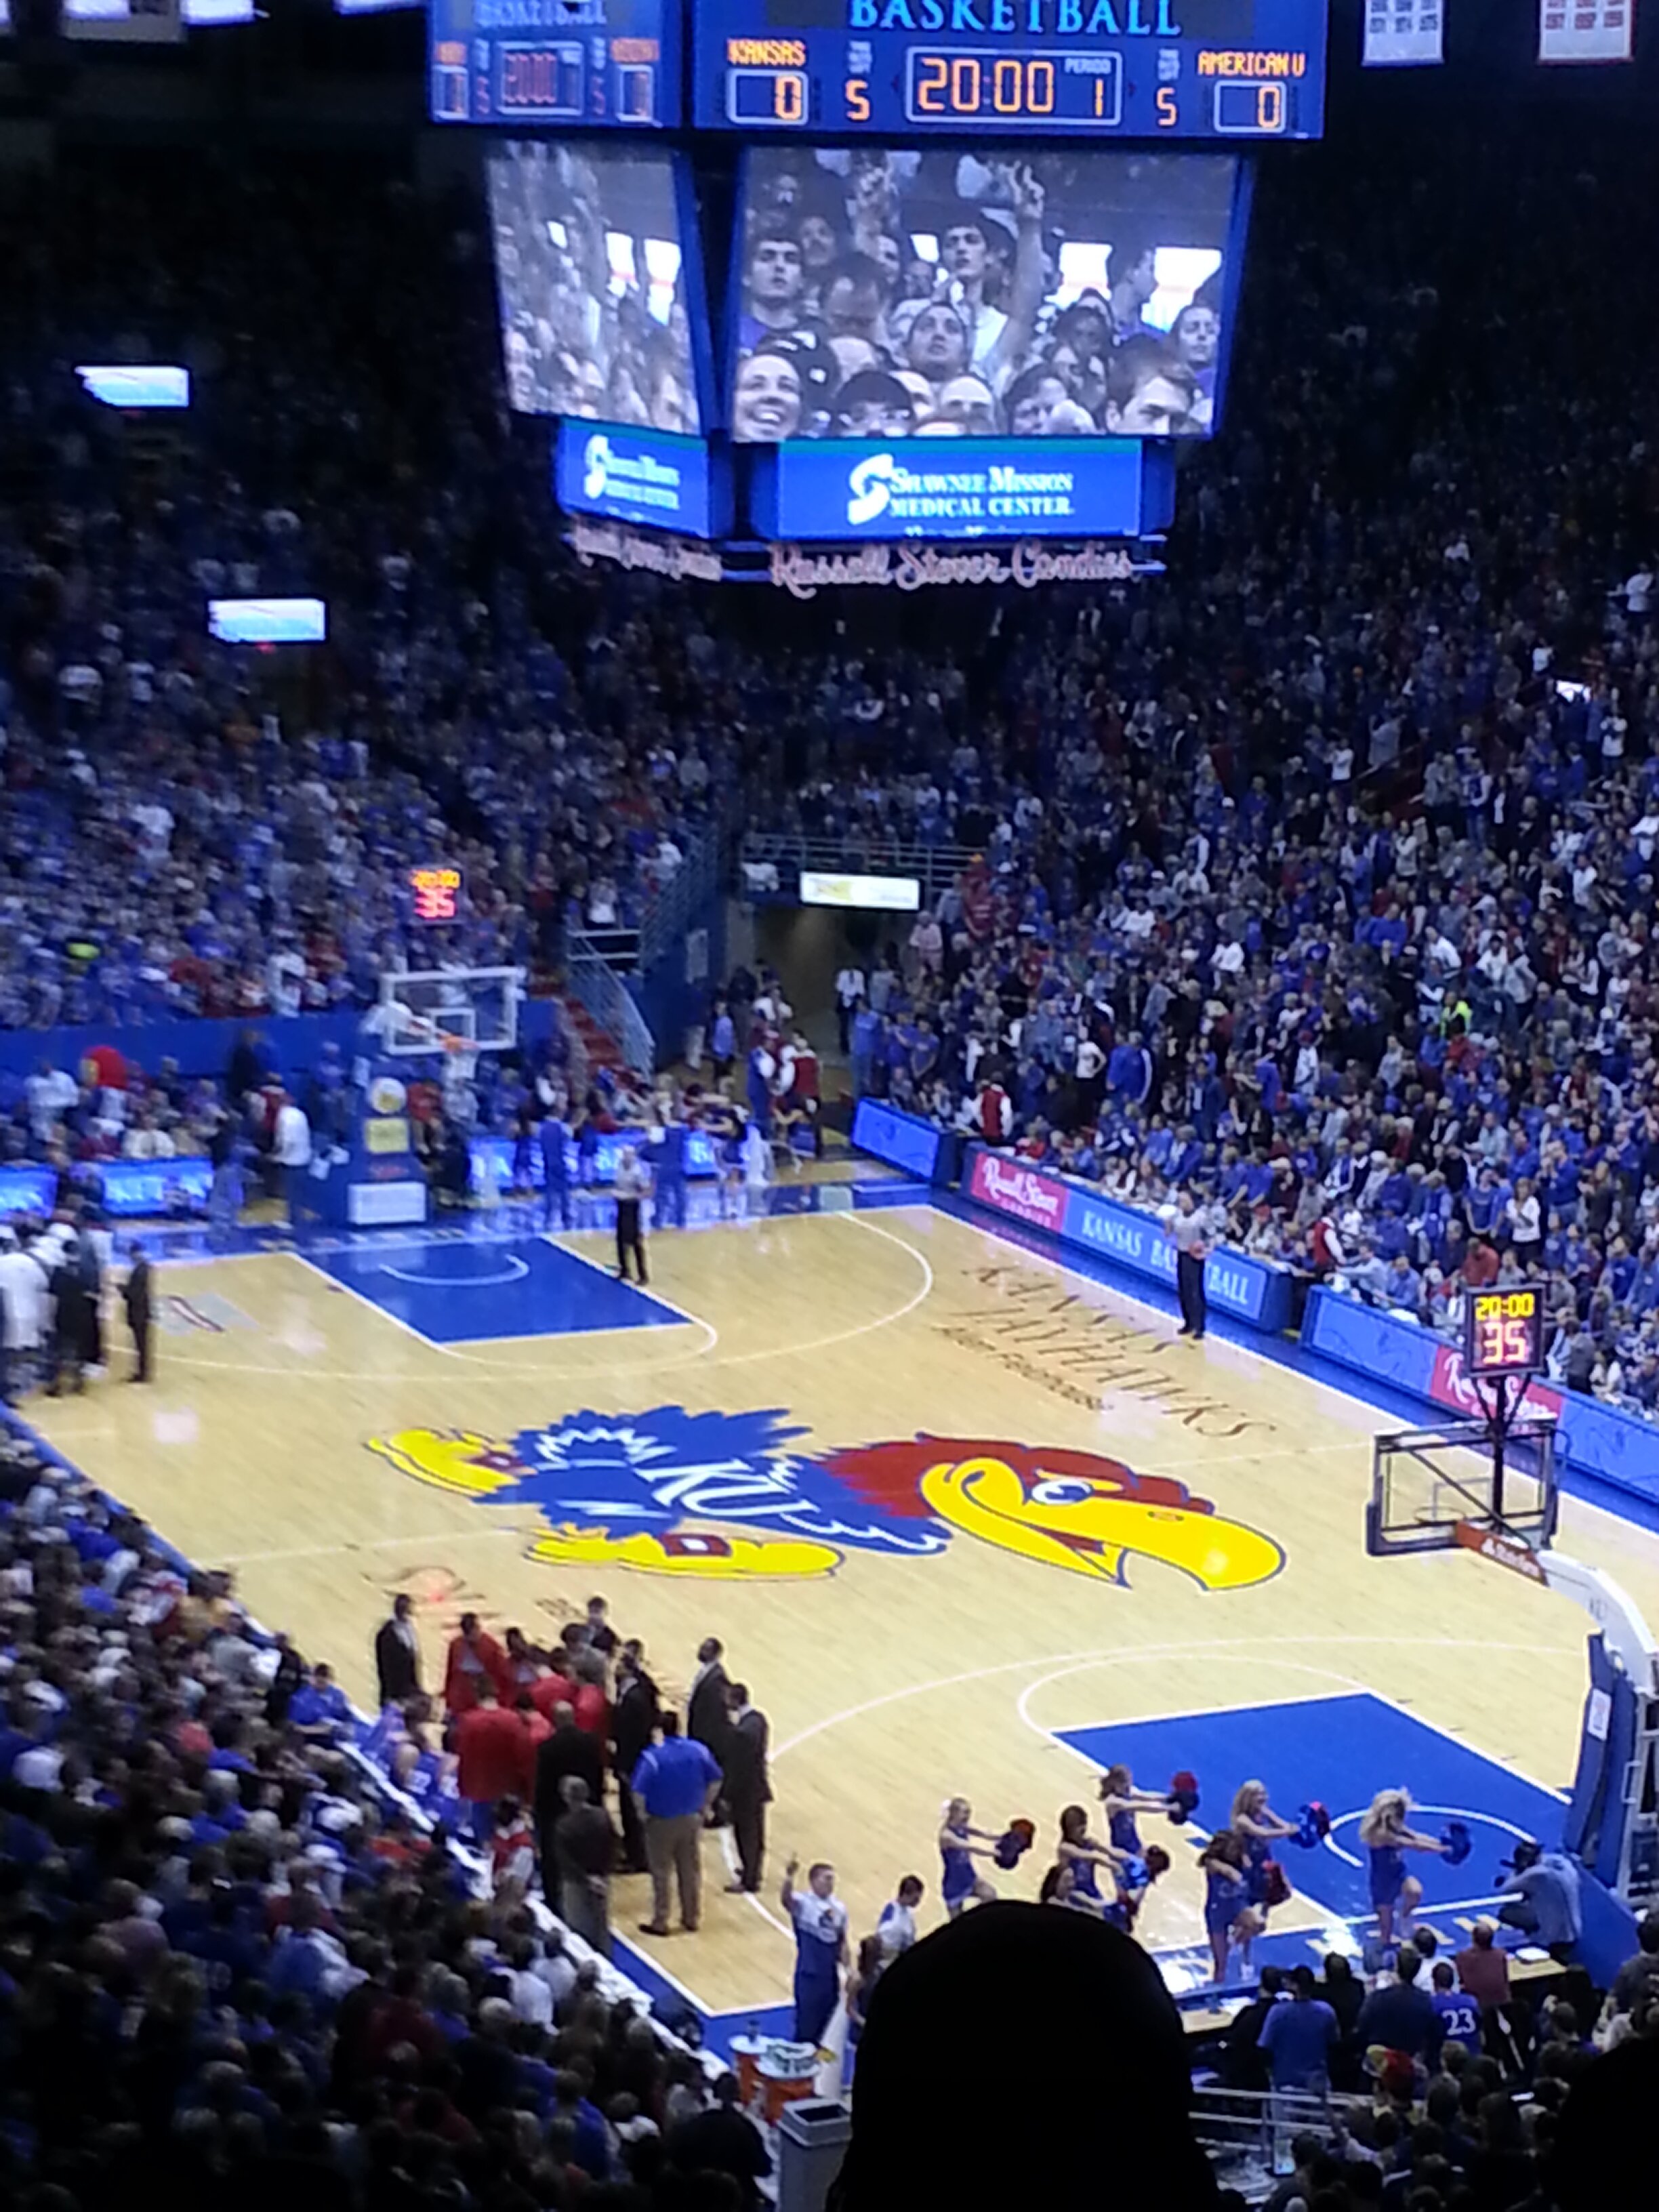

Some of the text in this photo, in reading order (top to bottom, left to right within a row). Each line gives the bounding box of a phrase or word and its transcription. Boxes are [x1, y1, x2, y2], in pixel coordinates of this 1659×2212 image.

[850, 0, 1180, 35] BASKETBALL
[727, 39, 806, 66] KANSAS
[1198, 51, 1289, 77] AMERICAN
[775, 76, 802, 121] 0
[918, 58, 1053, 112] 20:00
[1258, 87, 1280, 128] 0
[888, 496, 1071, 518] MEDICAL CENTER
[768, 542, 892, 599] Russell
[895, 541, 1009, 590] Stover
[1082, 1210, 1143, 1257] KANSAS
[1475, 1292, 1534, 1321] 20:00
[1482, 1319, 1528, 1364] 35
[1441, 2007, 1476, 2036] 23
